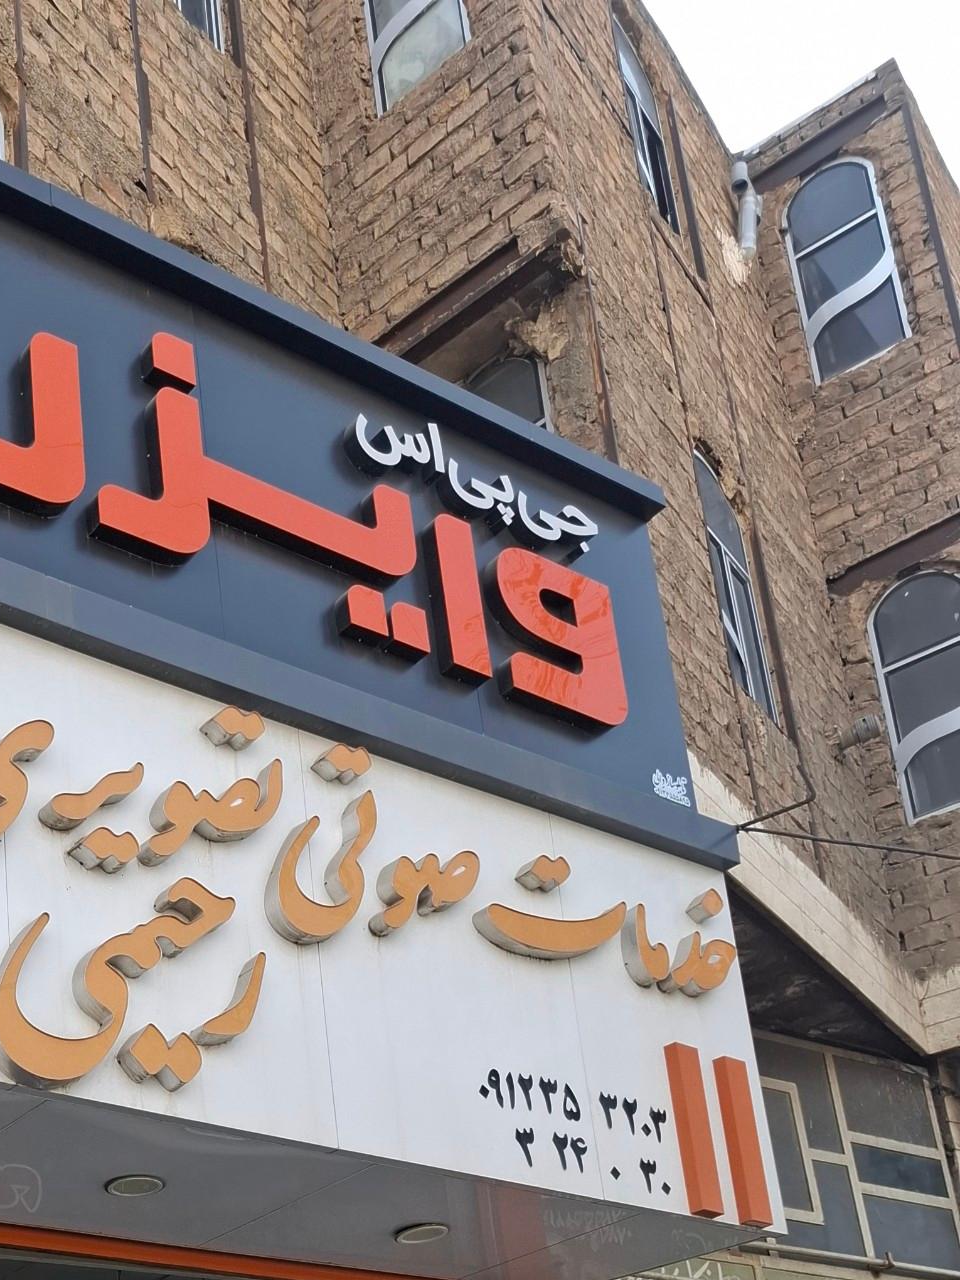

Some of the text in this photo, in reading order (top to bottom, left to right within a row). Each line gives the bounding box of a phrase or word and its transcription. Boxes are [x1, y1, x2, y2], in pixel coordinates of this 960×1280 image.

[264, 743, 480, 946] صوتی
[472, 855, 737, 998] خدمات
[478, 1068, 667, 1144] ۰۹۱۲۳۵ ۳۲۰۳
